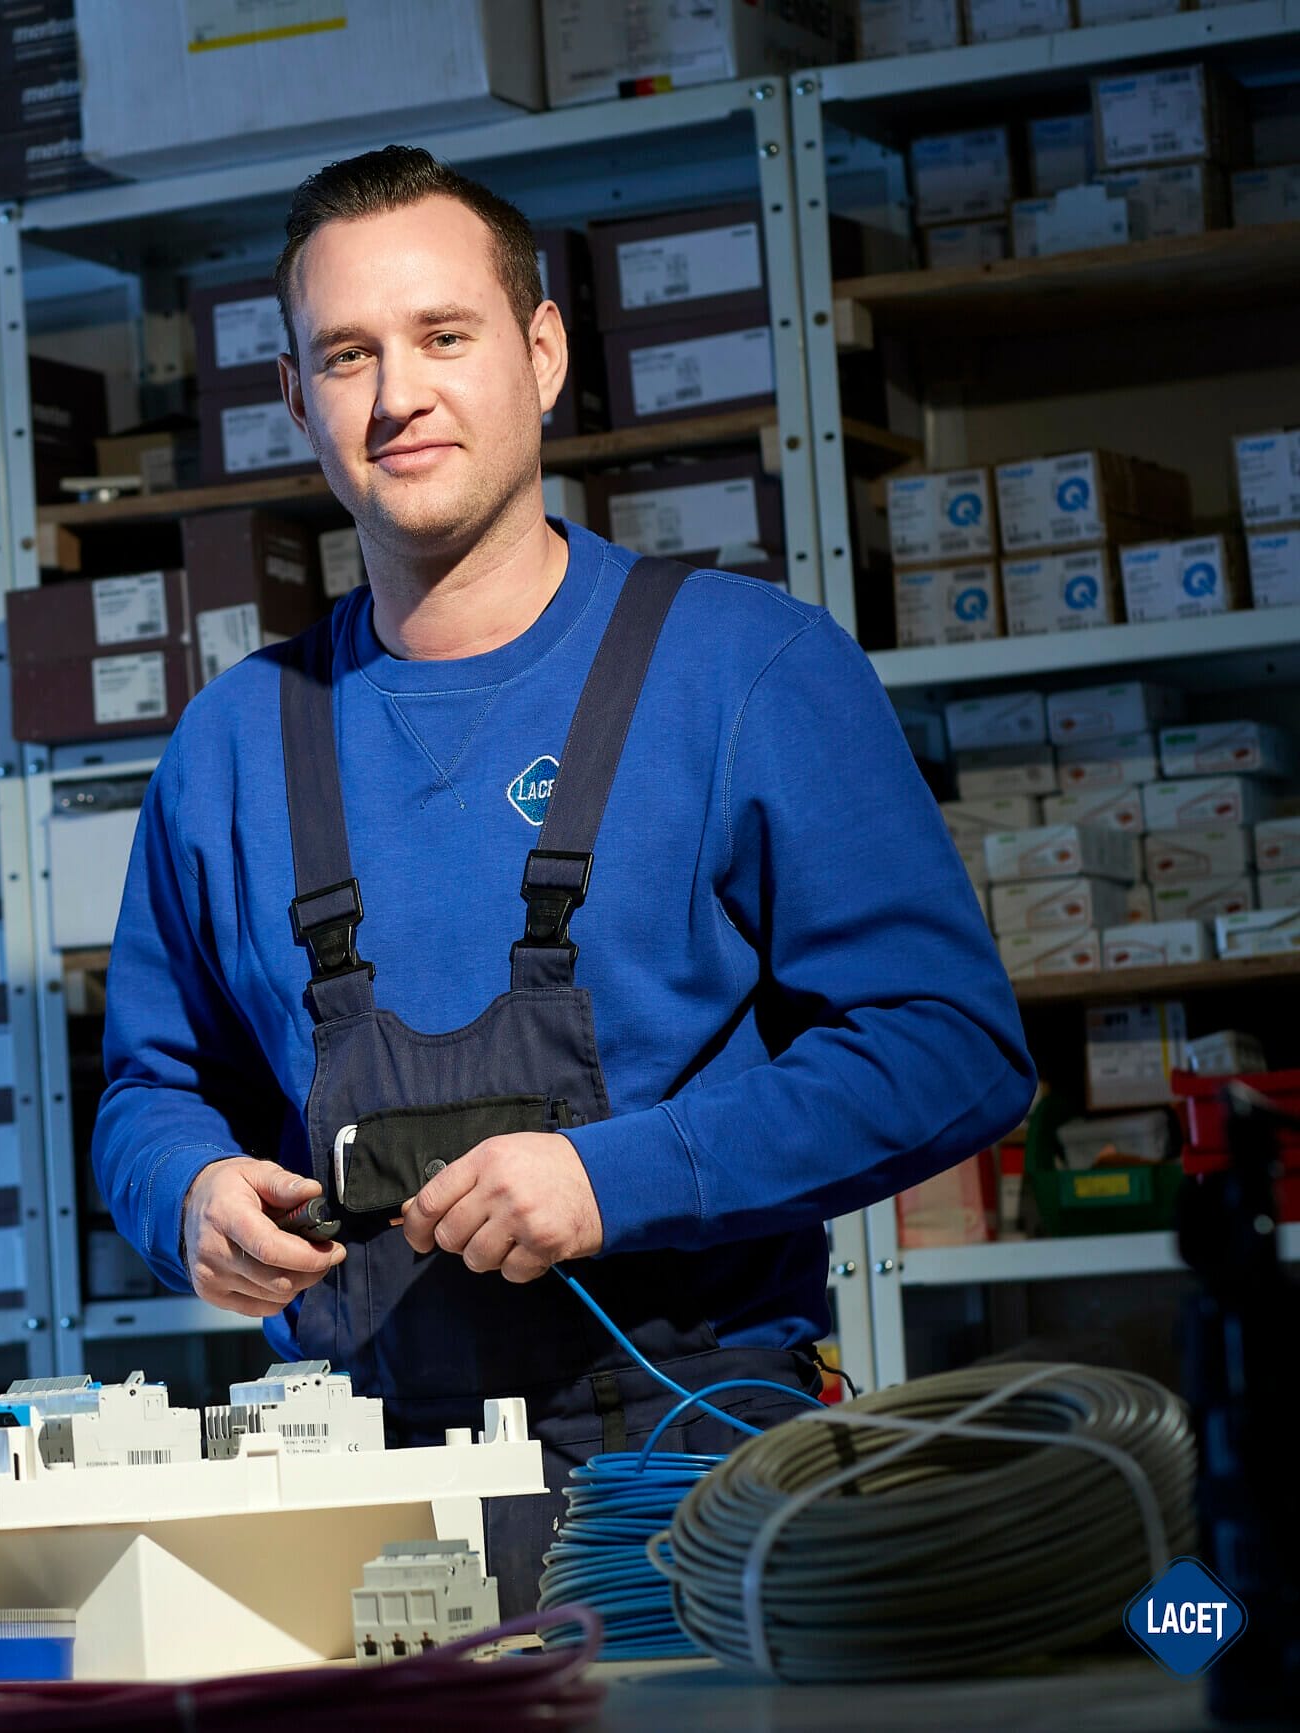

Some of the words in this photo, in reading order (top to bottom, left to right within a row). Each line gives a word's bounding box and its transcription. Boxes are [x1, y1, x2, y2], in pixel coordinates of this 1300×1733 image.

[21, 79, 79, 105] merte
[25, 139, 81, 163] merte
[949, 492, 982, 527] Q
[1057, 477, 1090, 512] Q
[1065, 575, 1098, 610] Q
[1182, 562, 1217, 598] Q
[955, 587, 989, 621] Q
